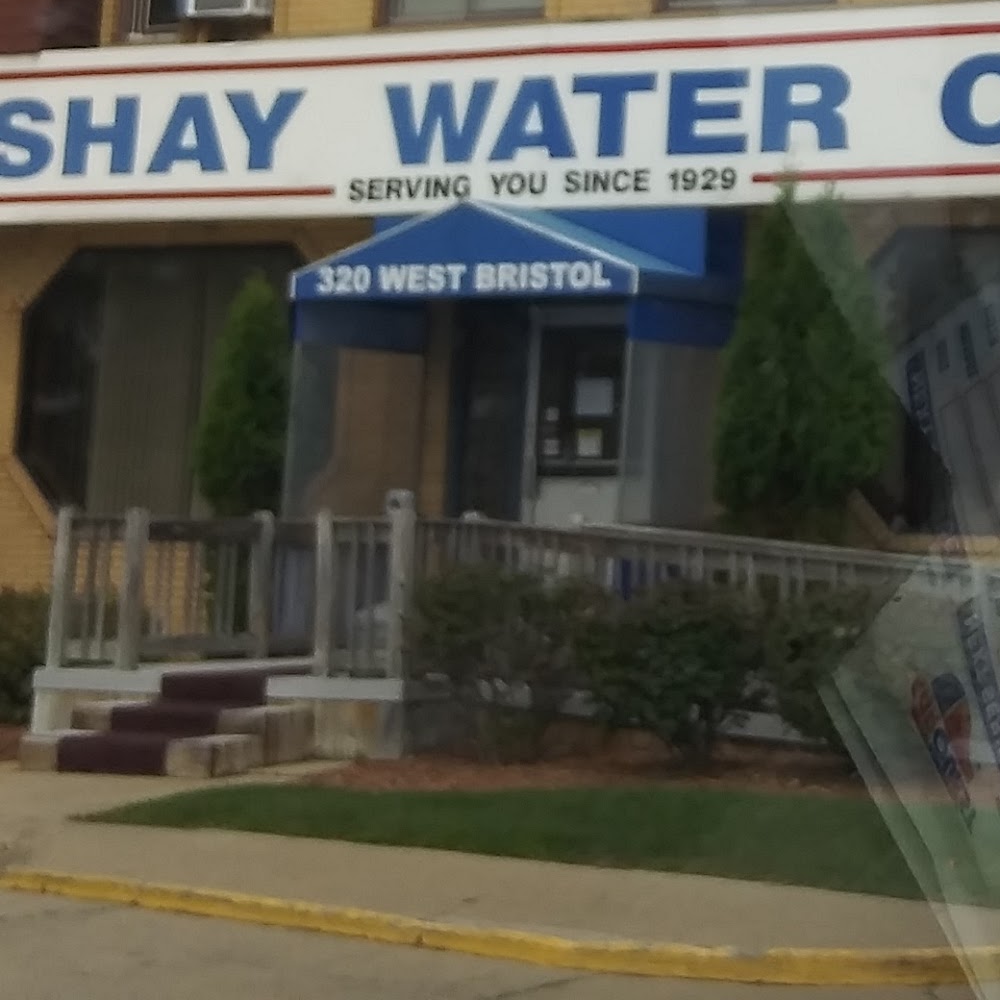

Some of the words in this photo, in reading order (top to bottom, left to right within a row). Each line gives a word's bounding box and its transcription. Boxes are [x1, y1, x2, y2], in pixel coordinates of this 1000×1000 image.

[0, 89, 305, 177] SHAY
[386, 64, 852, 166] WATER
[349, 174, 471, 202] SERVING
[490, 172, 547, 195] YOU
[564, 168, 649, 194] SINCE
[668, 167, 738, 191] 1929
[317, 264, 371, 295] 320
[379, 263, 467, 292] WEST
[474, 260, 612, 292] BRISTOL
